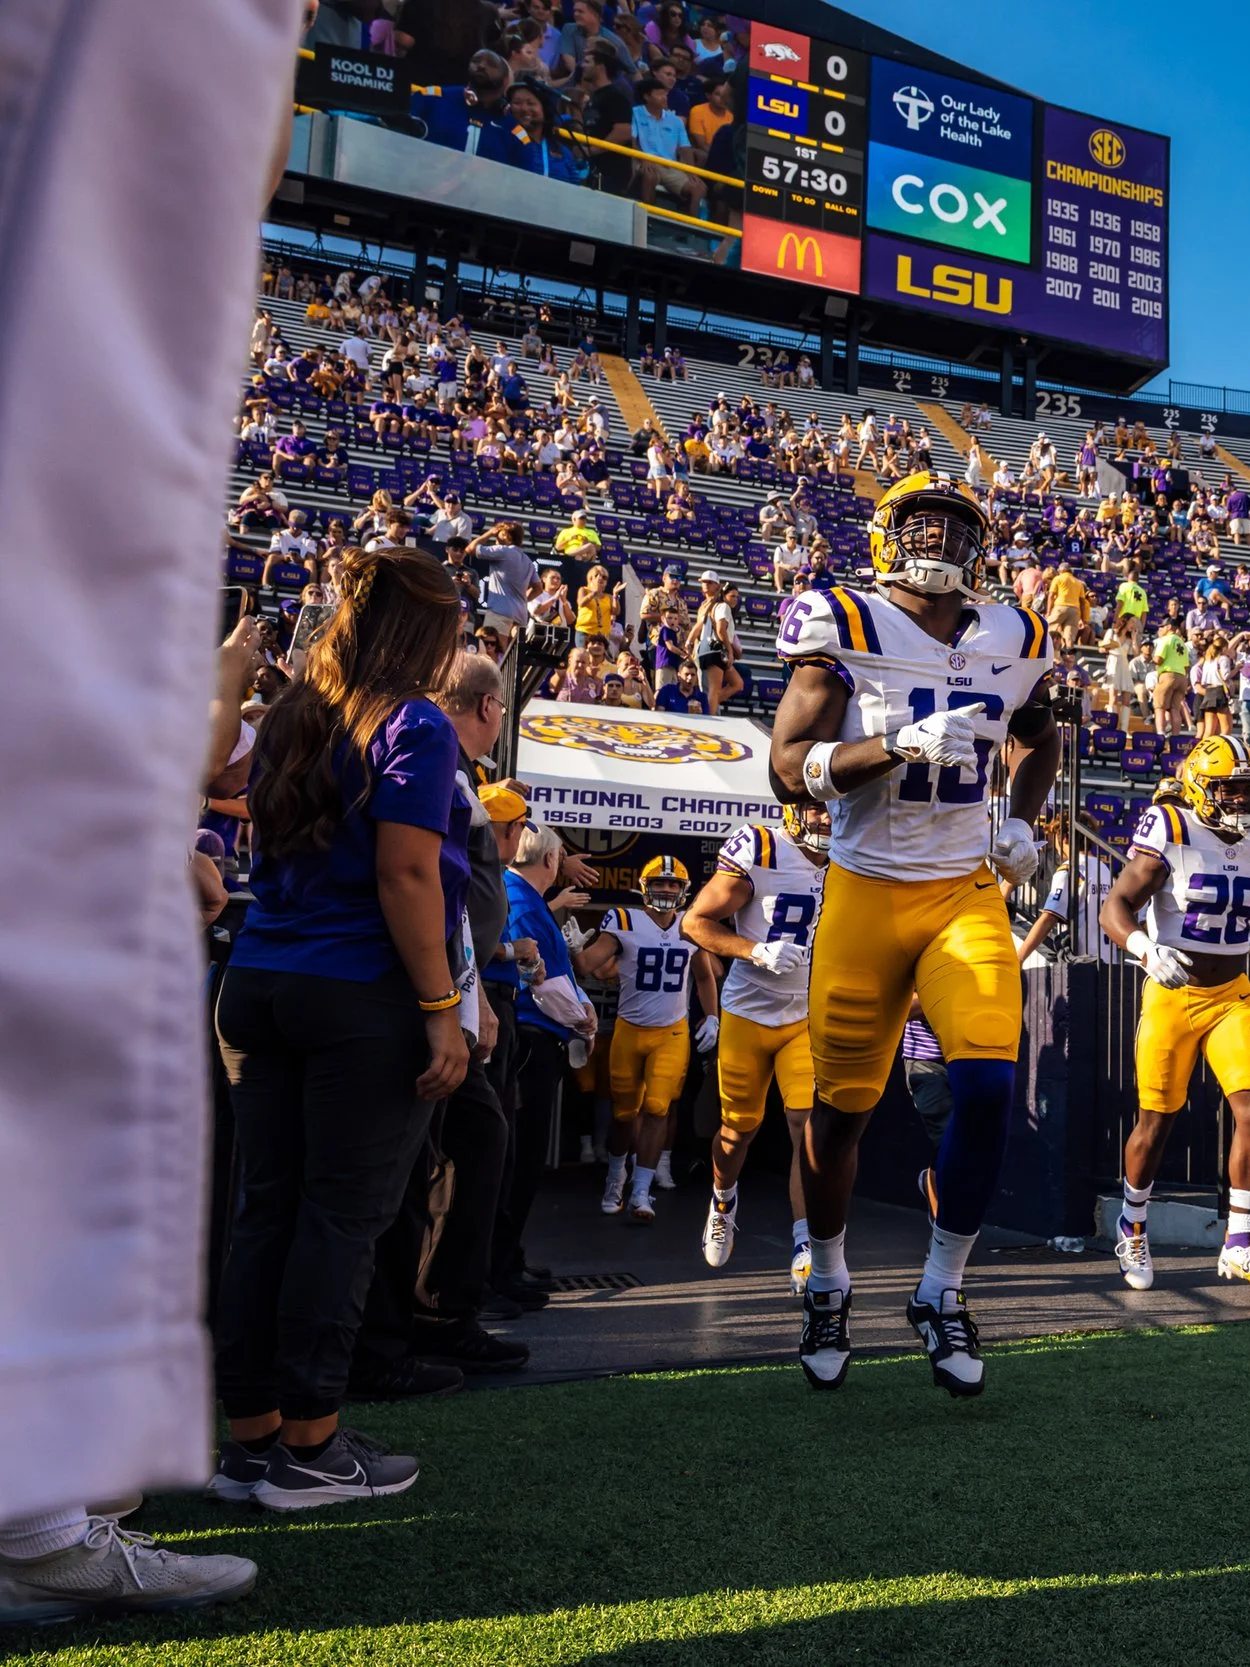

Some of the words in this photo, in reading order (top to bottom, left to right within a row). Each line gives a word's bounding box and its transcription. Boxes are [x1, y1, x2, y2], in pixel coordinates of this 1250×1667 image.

[331, 58, 372, 76] KOOL
[376, 67, 394, 80] DJ
[331, 72, 394, 92] SUPAMIKE
[826, 56, 848, 80] 0
[758, 95, 799, 118] LSU
[824, 111, 845, 136] 0
[940, 94, 966, 112] Our
[969, 102, 1000, 122] Lady
[940, 112, 956, 125] of
[958, 115, 979, 131] the
[982, 122, 1012, 140] Lake
[940, 126, 982, 147] Health
[795, 146, 817, 160] 1ST
[1092, 132, 1122, 166] SEC
[762, 156, 848, 196] 57:30
[1046, 160, 1164, 208] CHAMPIONSHIPS
[752, 184, 778, 197] DOWN
[792, 194, 802, 202] TO
[804, 196, 816, 206] GO
[825, 202, 844, 213] BALL
[845, 207, 858, 216] ON
[892, 174, 1007, 235] COX
[1047, 198, 1079, 222] 1935
[1090, 209, 1121, 232] 1936
[1130, 220, 1160, 242] 1958
[1048, 225, 1076, 248] 1961
[1090, 235, 1120, 258] 1970
[1130, 245, 1160, 268] 1986
[896, 254, 1012, 314] LSU
[1046, 251, 1078, 274] 1988
[1089, 261, 1120, 284] 2001
[1128, 270, 1162, 294] 2003
[1046, 277, 1082, 300] 2007
[1093, 288, 1120, 310] 2011
[1132, 297, 1162, 319] 2019
[893, 370, 911, 380] 234
[932, 376, 949, 386] 235
[1035, 392, 1082, 418] 235
[1163, 409, 1180, 418] 235
[1201, 414, 1218, 424] 236
[947, 677, 972, 686] LSU
[543, 810, 592, 824] 1958
[609, 815, 663, 829] 2003
[679, 820, 732, 834] 2007
[1094, 804, 1113, 812] LSU
[1108, 836, 1129, 844] LSU
[1223, 864, 1239, 872] LSU
[766, 892, 816, 948] 8
[636, 947, 689, 992] 89
